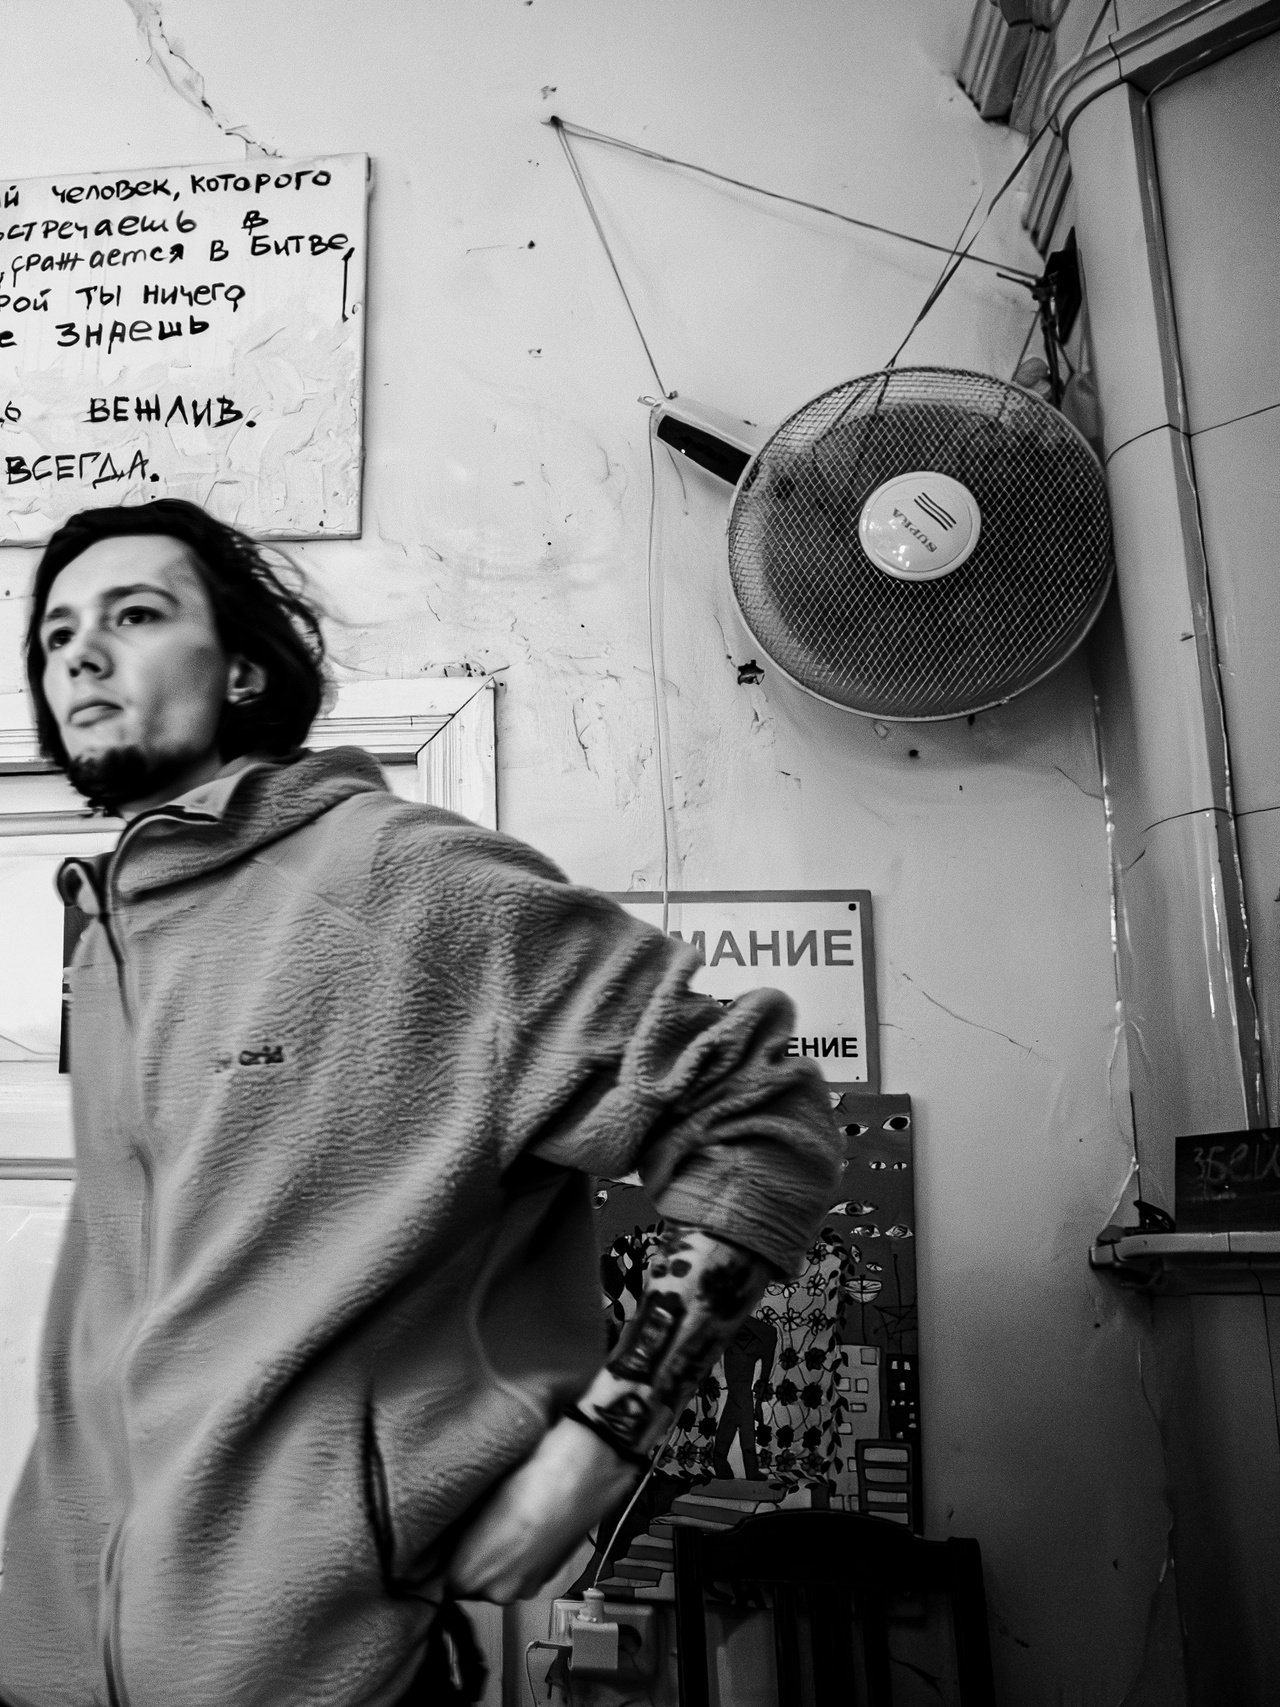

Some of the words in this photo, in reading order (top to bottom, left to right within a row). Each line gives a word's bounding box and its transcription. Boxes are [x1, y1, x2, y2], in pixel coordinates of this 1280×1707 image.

[190, 169, 332, 196] которого
[142, 283, 247, 312] ничего
[84, 394, 257, 430] ВЕЖЛИВ.
[5, 451, 161, 489] ВСЕГДА.
[891, 507, 938, 553] SUPRA
